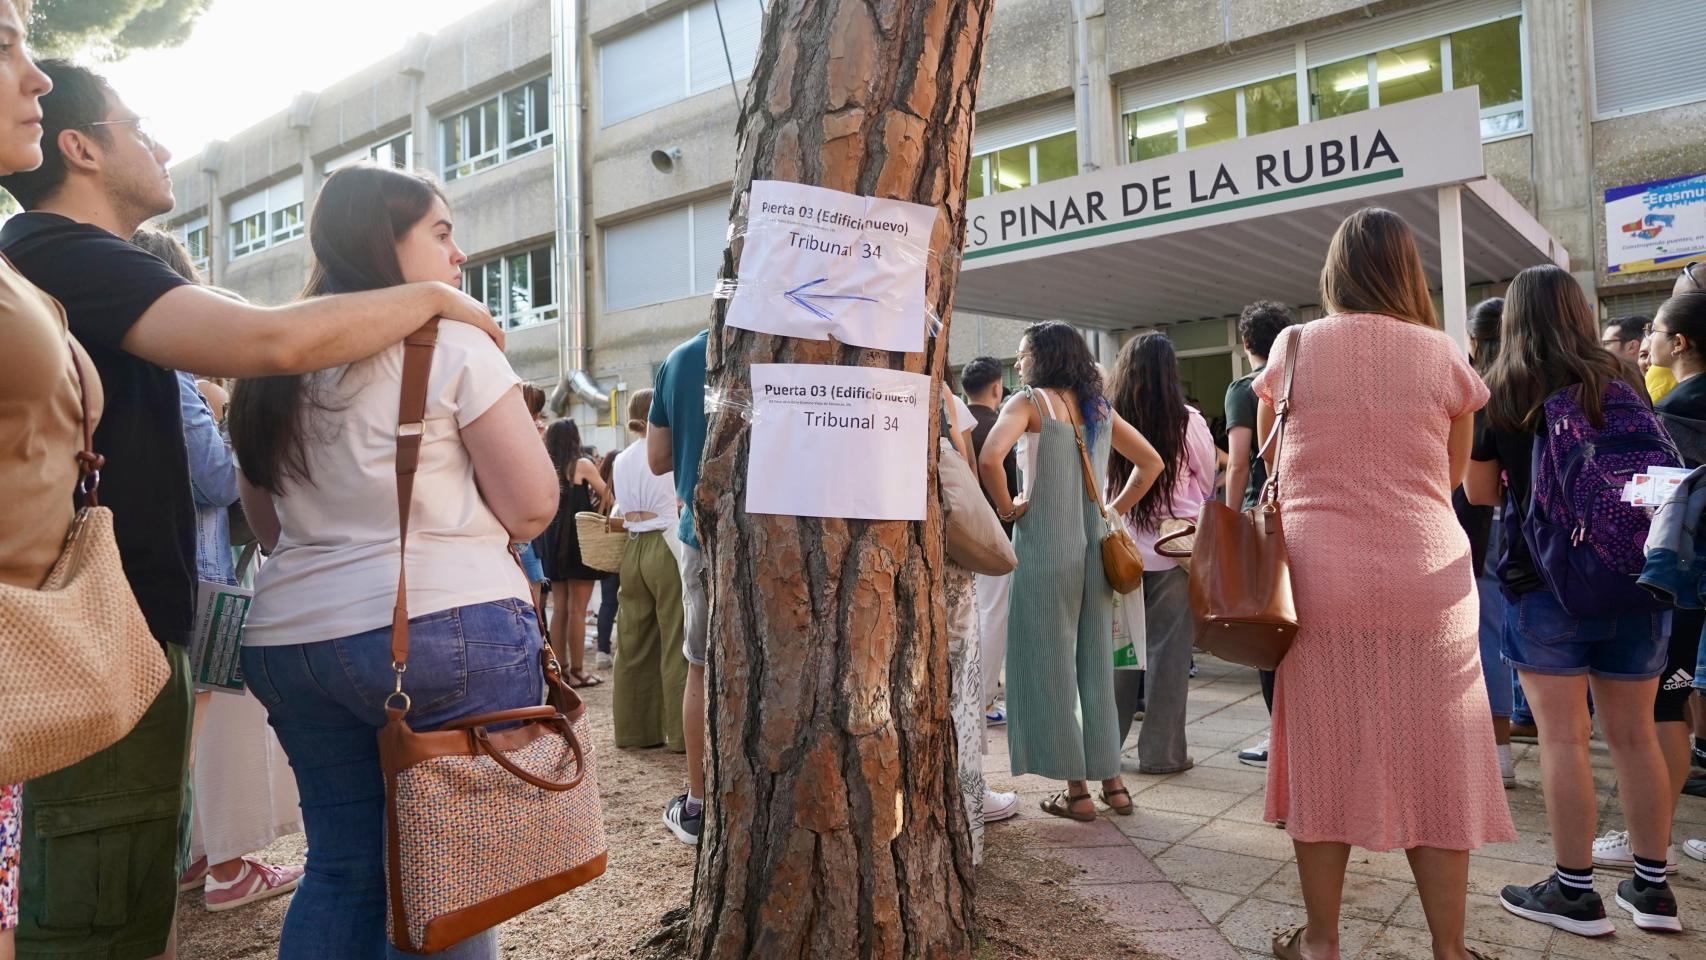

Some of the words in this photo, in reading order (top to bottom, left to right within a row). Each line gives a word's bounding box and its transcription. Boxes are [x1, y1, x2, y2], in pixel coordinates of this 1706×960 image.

[965, 215, 988, 247] S
[1000, 190, 1108, 241] PINAR
[1121, 175, 1173, 218] DE
[1188, 163, 1241, 203] LA
[1255, 128, 1400, 191] RUBIA
[1649, 187, 1706, 205] Erasmu
[762, 201, 795, 216] Perta
[799, 206, 814, 219] 03
[865, 219, 909, 237] nuevo)
[789, 231, 852, 257] Tribunal
[861, 243, 882, 260] 34
[764, 384, 807, 396] Puerta
[810, 385, 827, 397] 03
[830, 385, 882, 401] (Edificio
[804, 411, 875, 430] Tribunal
[883, 415, 899, 432] 34
